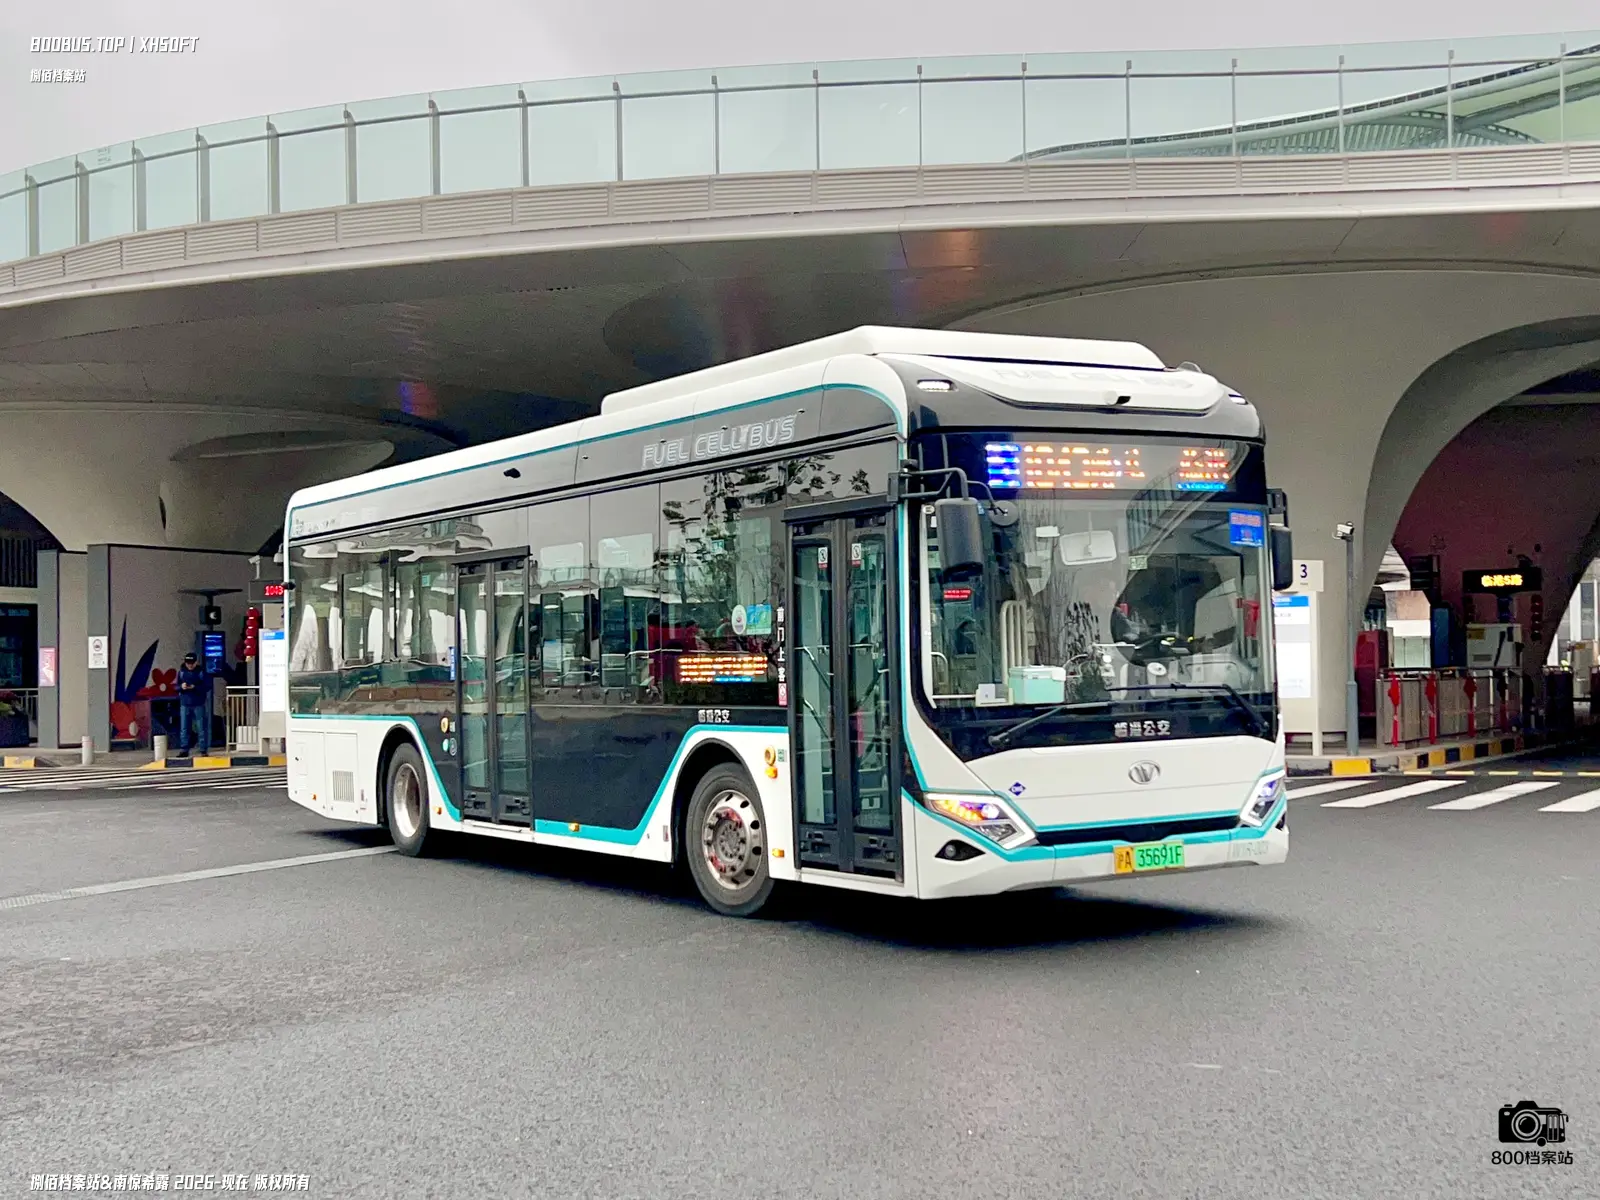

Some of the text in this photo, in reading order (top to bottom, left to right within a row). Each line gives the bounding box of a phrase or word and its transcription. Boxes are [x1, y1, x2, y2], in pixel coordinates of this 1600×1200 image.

[641, 414, 797, 469] FUEL CELL BUS
[1300, 564, 1308, 578] 3
[1137, 845, 1183, 868] 35691F
